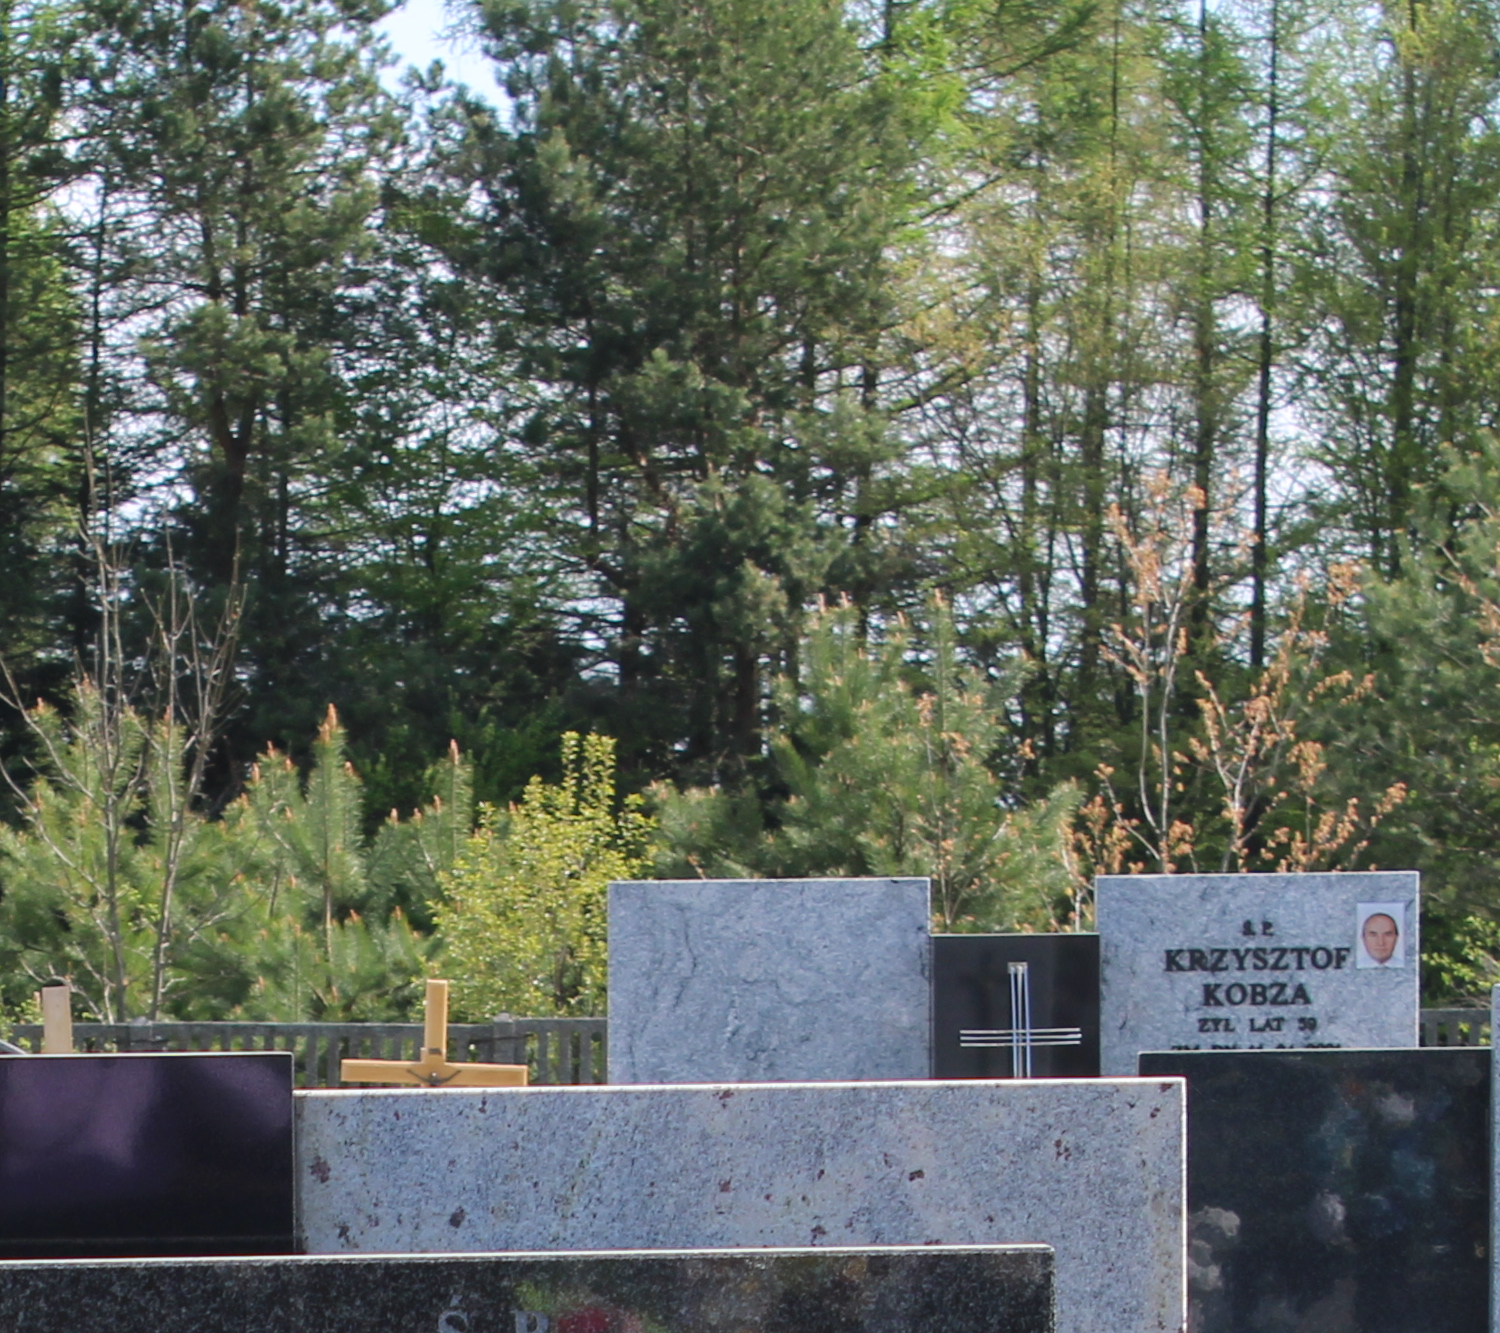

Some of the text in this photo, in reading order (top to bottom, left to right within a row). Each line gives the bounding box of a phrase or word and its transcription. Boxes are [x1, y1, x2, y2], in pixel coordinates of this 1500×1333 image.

[1164, 947, 1350, 973] KRZYSZTOF
[1202, 982, 1312, 1007] KOBZA
[1249, 1016, 1285, 1032] LAT
